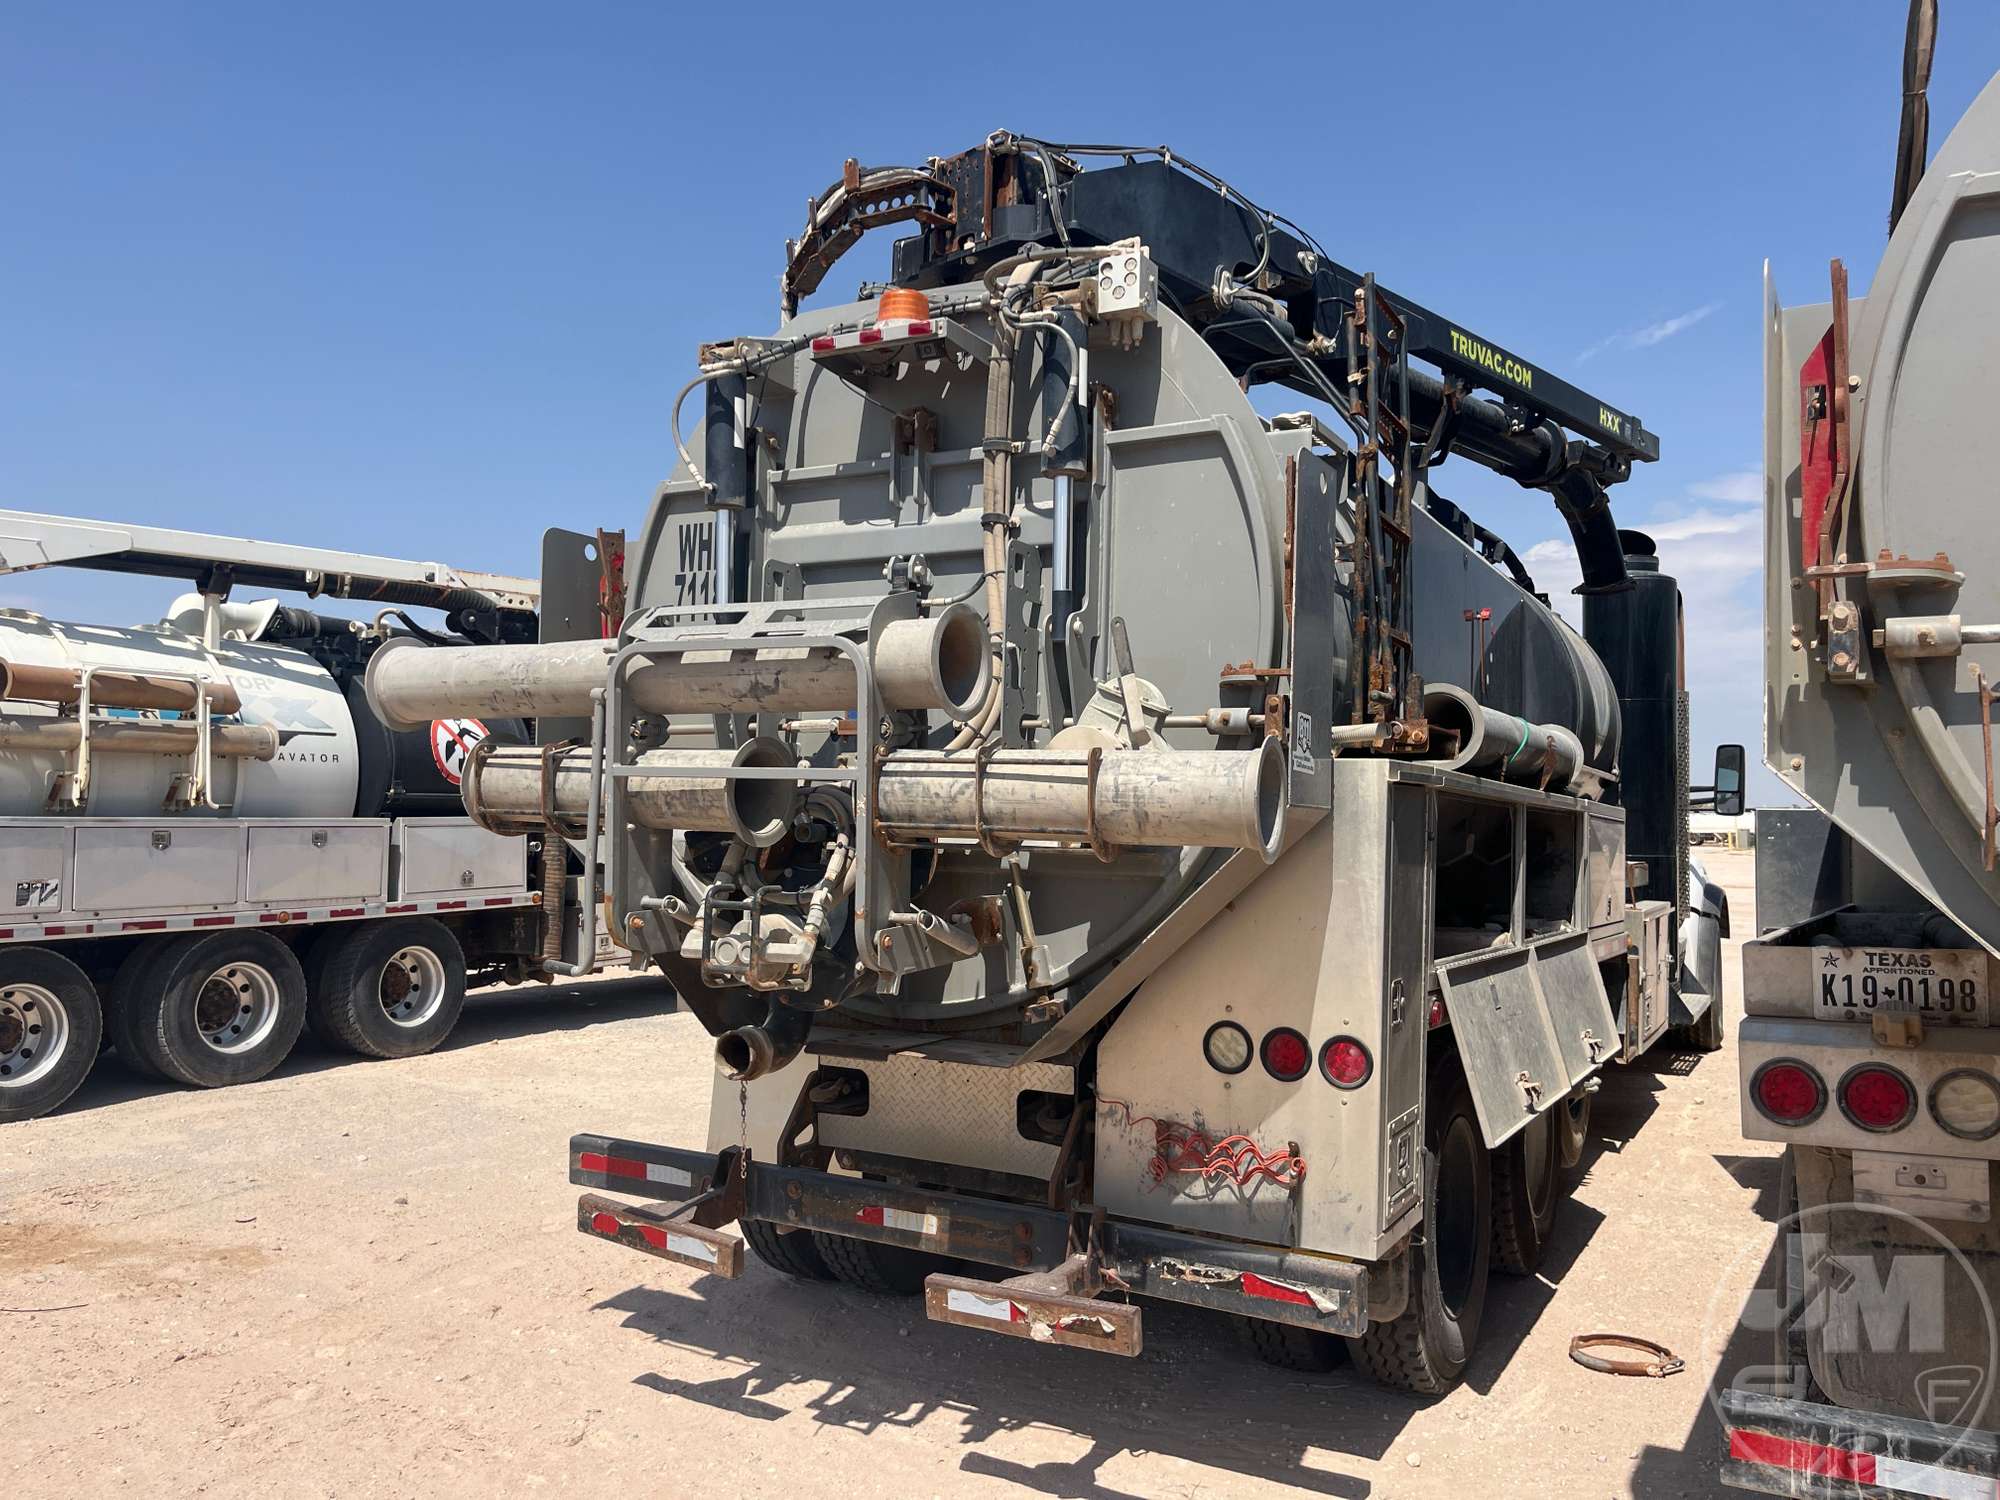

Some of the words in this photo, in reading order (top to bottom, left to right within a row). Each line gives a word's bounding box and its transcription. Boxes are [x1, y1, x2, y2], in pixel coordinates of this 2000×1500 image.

[1451, 330, 1532, 389] TRUVAC.COM
[1600, 407, 1621, 435] HXX
[679, 522, 717, 572] WH
[1862, 967, 1935, 976] APPORTIONED
[1865, 952, 1932, 968] TEXAS
